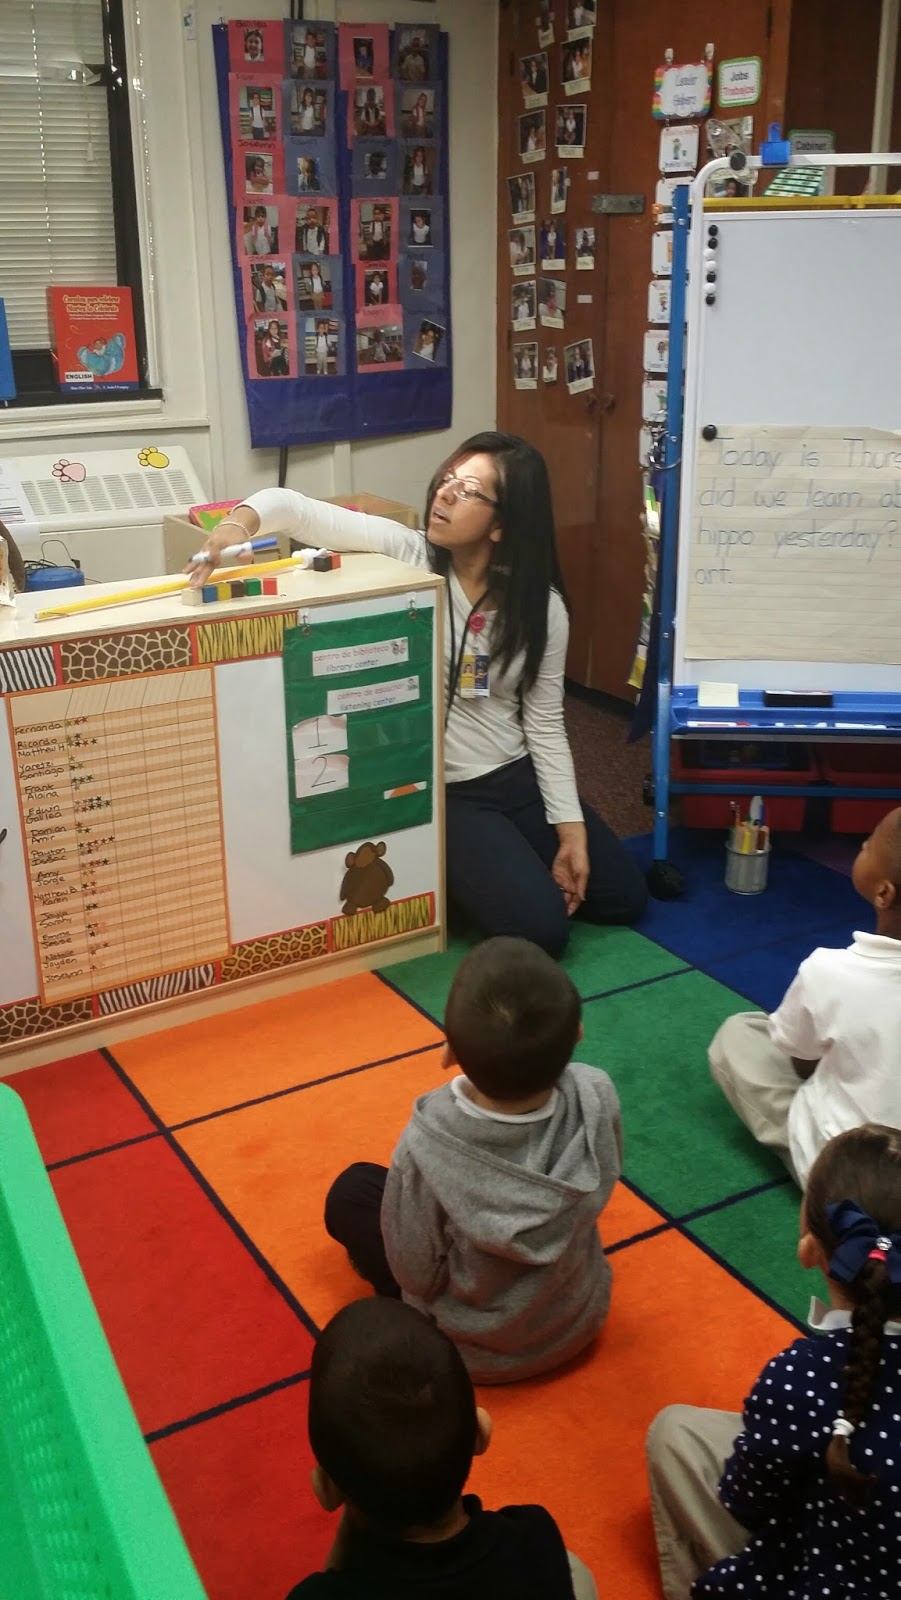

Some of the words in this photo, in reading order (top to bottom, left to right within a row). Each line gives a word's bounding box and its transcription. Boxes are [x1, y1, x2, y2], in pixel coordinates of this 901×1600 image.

[730, 71, 749, 82] Jobs
[722, 85, 755, 97] Trabajos
[67, 304, 86, 312] Stories
[713, 437, 782, 478] Today
[801, 444, 820, 467] is
[699, 477, 736, 507] did
[753, 490, 787, 508] we
[806, 478, 862, 507] learn
[698, 516, 754, 556] hippo
[773, 518, 898, 564] yesterday?
[314, 653, 340, 662] centro
[326, 663, 353, 672] library
[354, 659, 379, 669] center
[337, 691, 362, 700] centro
[363, 689, 373, 697] de
[340, 701, 372, 711] listening
[373, 696, 396, 706] center
[14, 723, 62, 735] Fernanda
[308, 717, 328, 749] 1
[17, 737, 57, 750] Ricardo
[17, 745, 56, 757] Matthew
[18, 761, 54, 774] Yaretzi
[19, 766, 65, 780] Santiago
[311, 756, 336, 788] 2
[24, 784, 55, 794] Frank
[26, 790, 59, 801] Alaina
[28, 804, 60, 817] Edwin
[25, 811, 62, 824] Galilea
[31, 826, 67, 837] Damian
[31, 835, 56, 844] Amir
[31, 848, 66, 860] Payton
[35, 876, 65, 887] Jorge
[33, 890, 69, 901] Matthew
[69, 886, 78, 894] B
[42, 896, 69, 906] Karen
[42, 931, 70, 941] Emma
[41, 937, 73, 950] Jesse
[43, 958, 77, 969] Jayden
